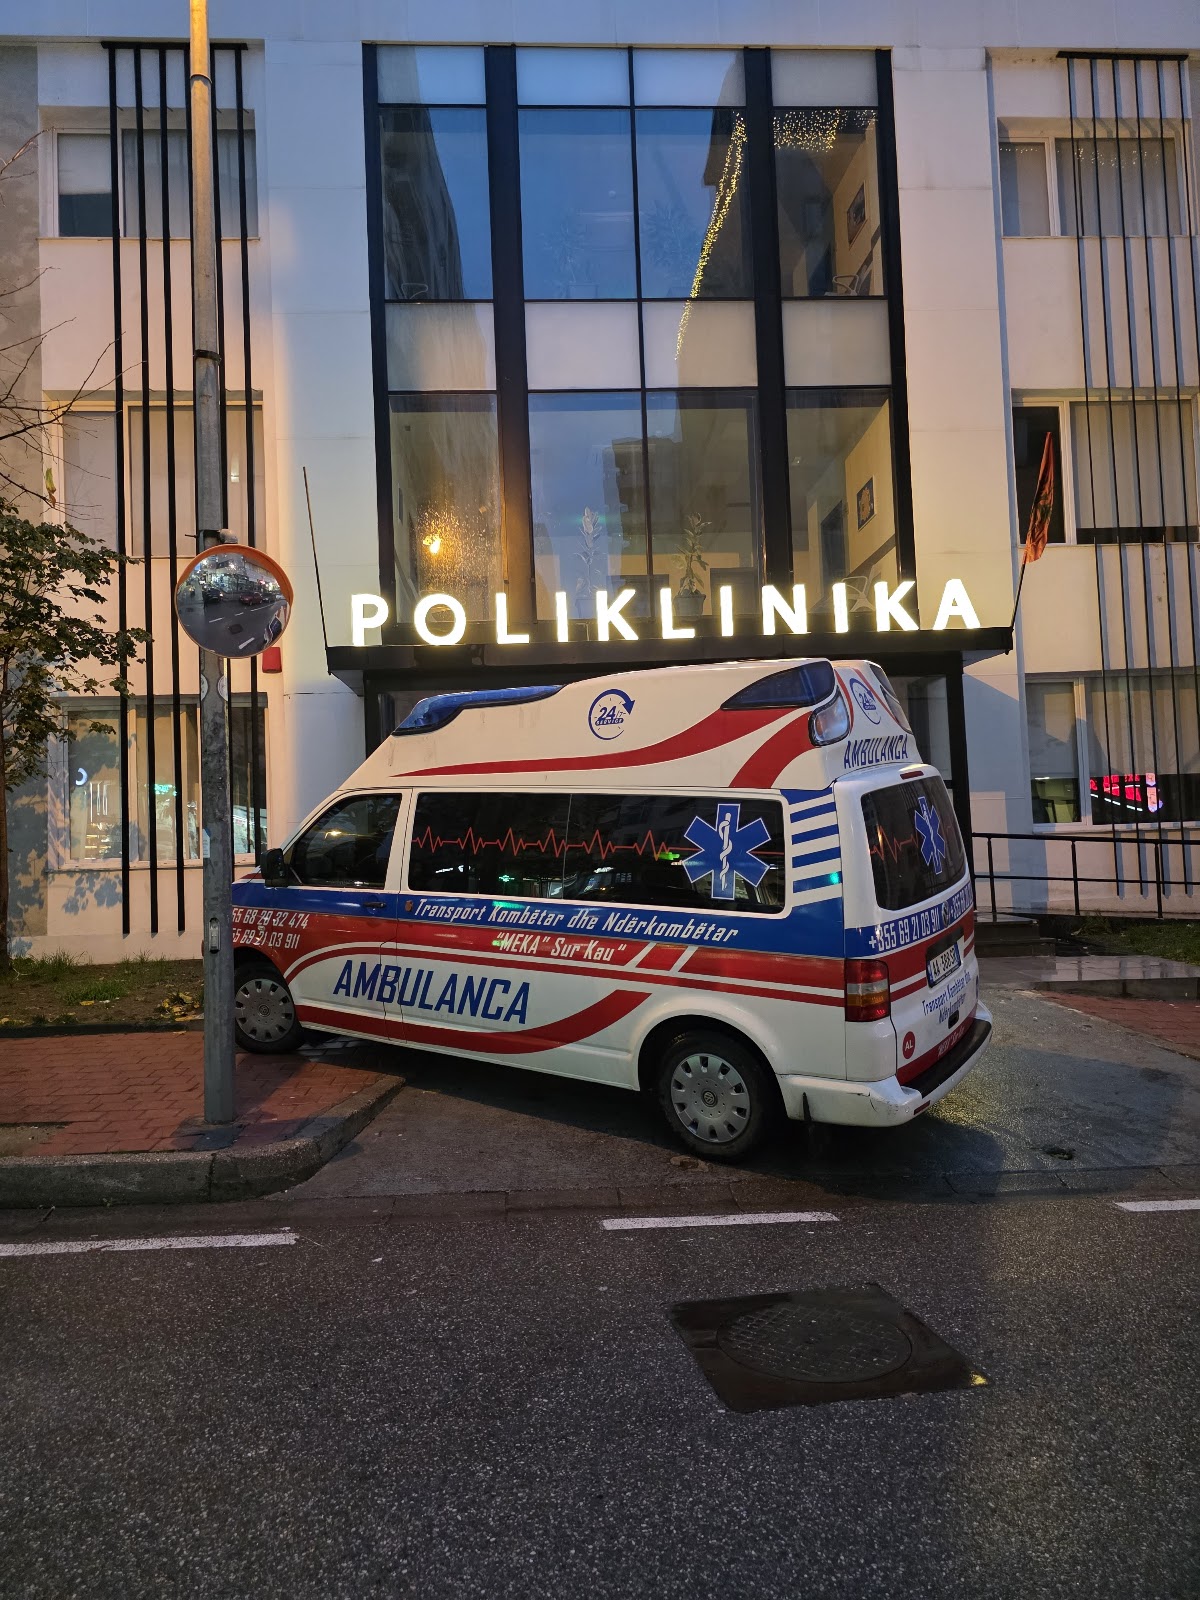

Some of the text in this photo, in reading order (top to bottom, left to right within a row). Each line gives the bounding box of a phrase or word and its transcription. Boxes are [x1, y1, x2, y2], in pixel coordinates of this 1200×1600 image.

[351, 578, 982, 646] POLIKLINIKA
[844, 734, 909, 769] AMBULANCA
[243, 909, 259, 924] 68
[273, 912, 289, 927] 32
[288, 913, 310, 929] 474
[413, 898, 739, 943] Transport Kombëtar dhe Ndërkombëtar
[869, 907, 940, 951] +355 69 21 03 911
[240, 929, 256, 945] 69
[268, 932, 283, 948] 03
[285, 933, 300, 949] 911
[551, 937, 581, 958] Sur
[333, 959, 531, 1025] AMBULANCA
[904, 1040, 914, 1052] AL
